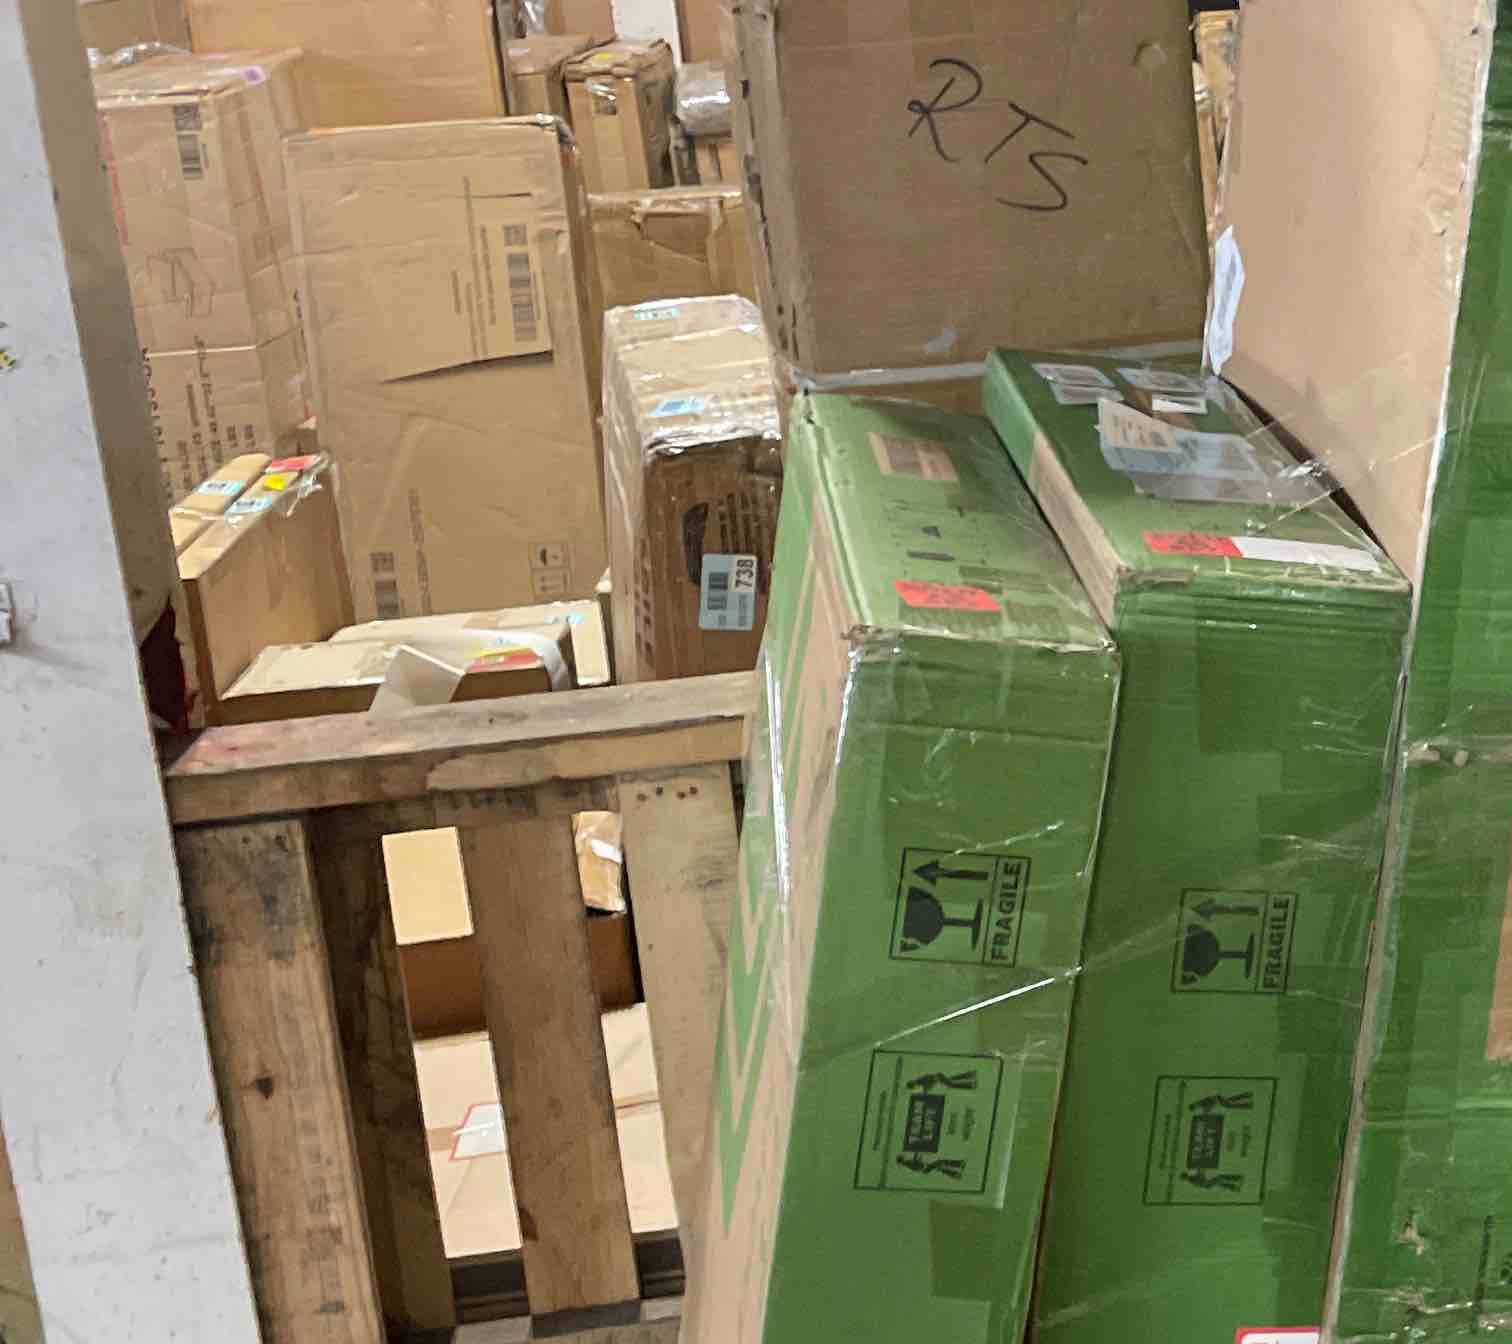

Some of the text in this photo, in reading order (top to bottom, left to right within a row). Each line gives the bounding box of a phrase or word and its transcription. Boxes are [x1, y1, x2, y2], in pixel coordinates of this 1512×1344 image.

[907, 58, 1089, 212] RTS
[990, 860, 1022, 962] FRAGILE
[1262, 895, 1291, 990] FRAGILE
